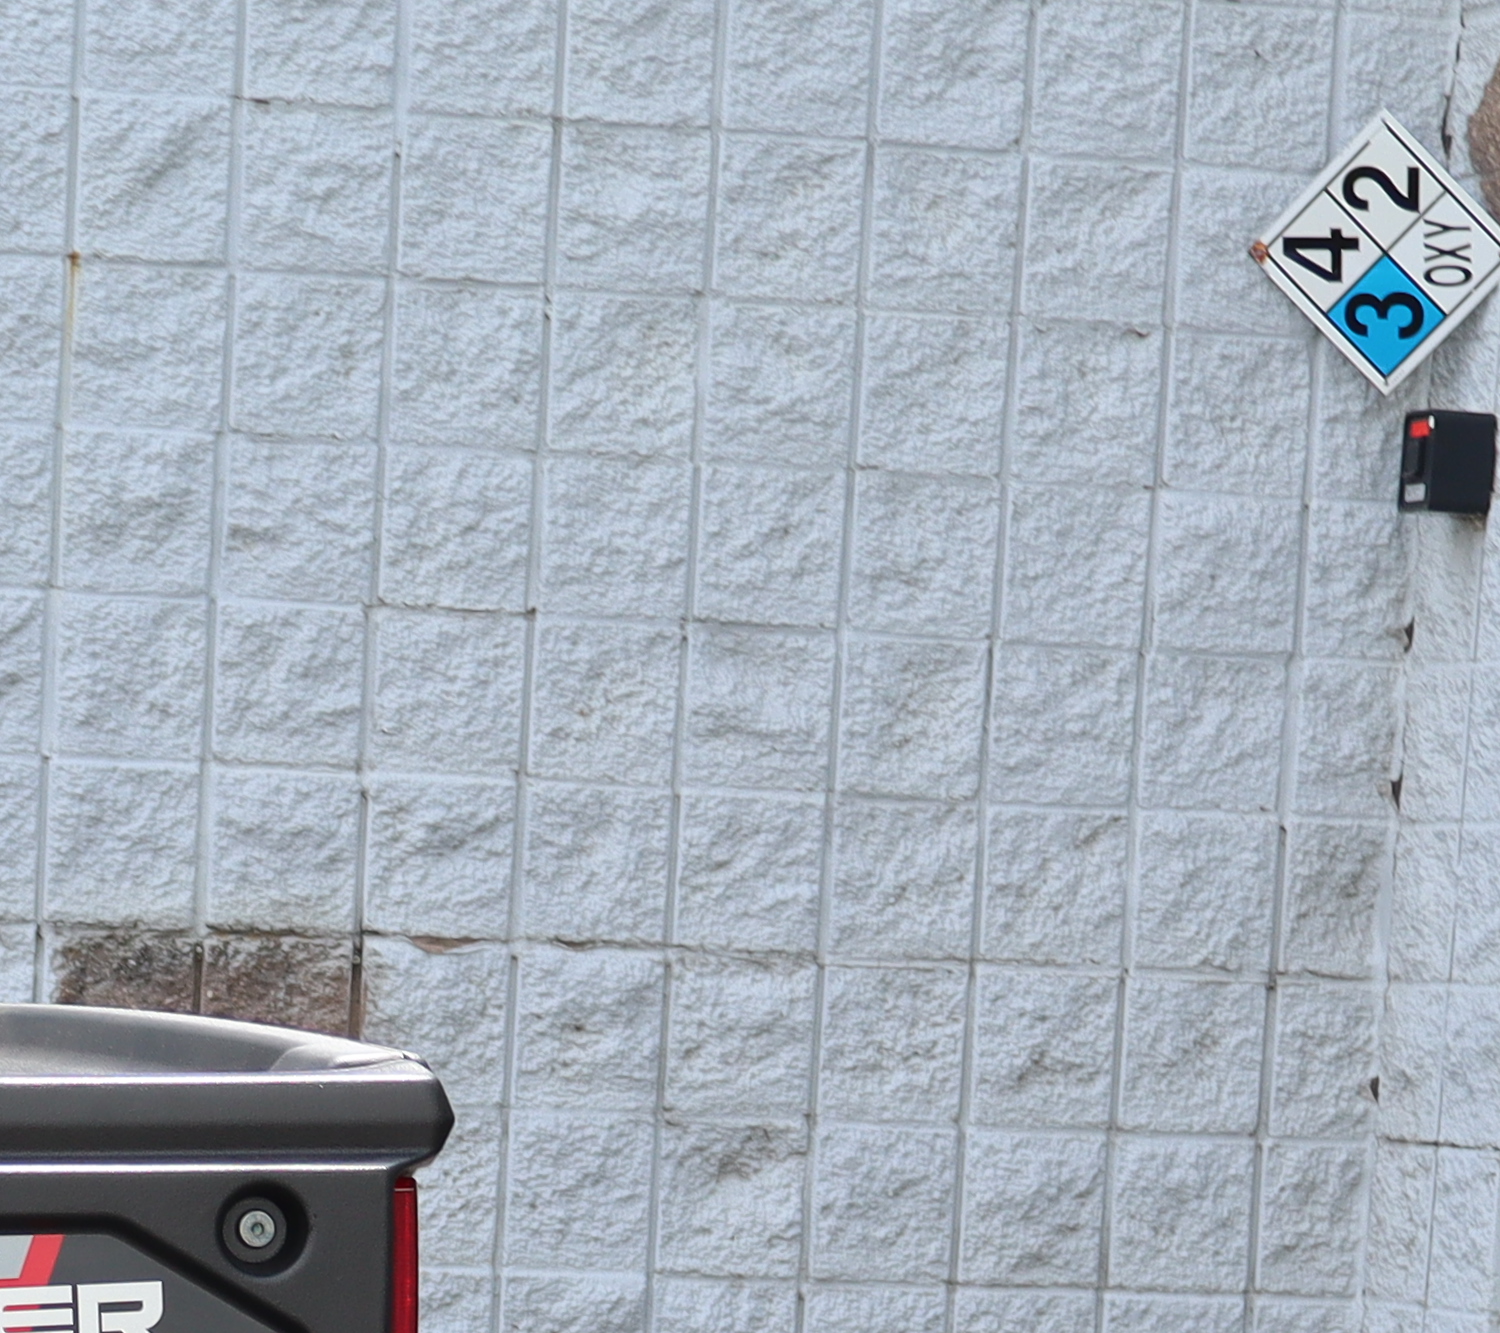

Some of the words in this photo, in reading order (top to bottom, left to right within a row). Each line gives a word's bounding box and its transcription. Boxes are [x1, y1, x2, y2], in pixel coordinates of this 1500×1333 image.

[1343, 166, 1419, 213] 2
[1283, 228, 1359, 283] 4
[1424, 219, 1473, 288] OXY
[1345, 292, 1424, 339] 3
